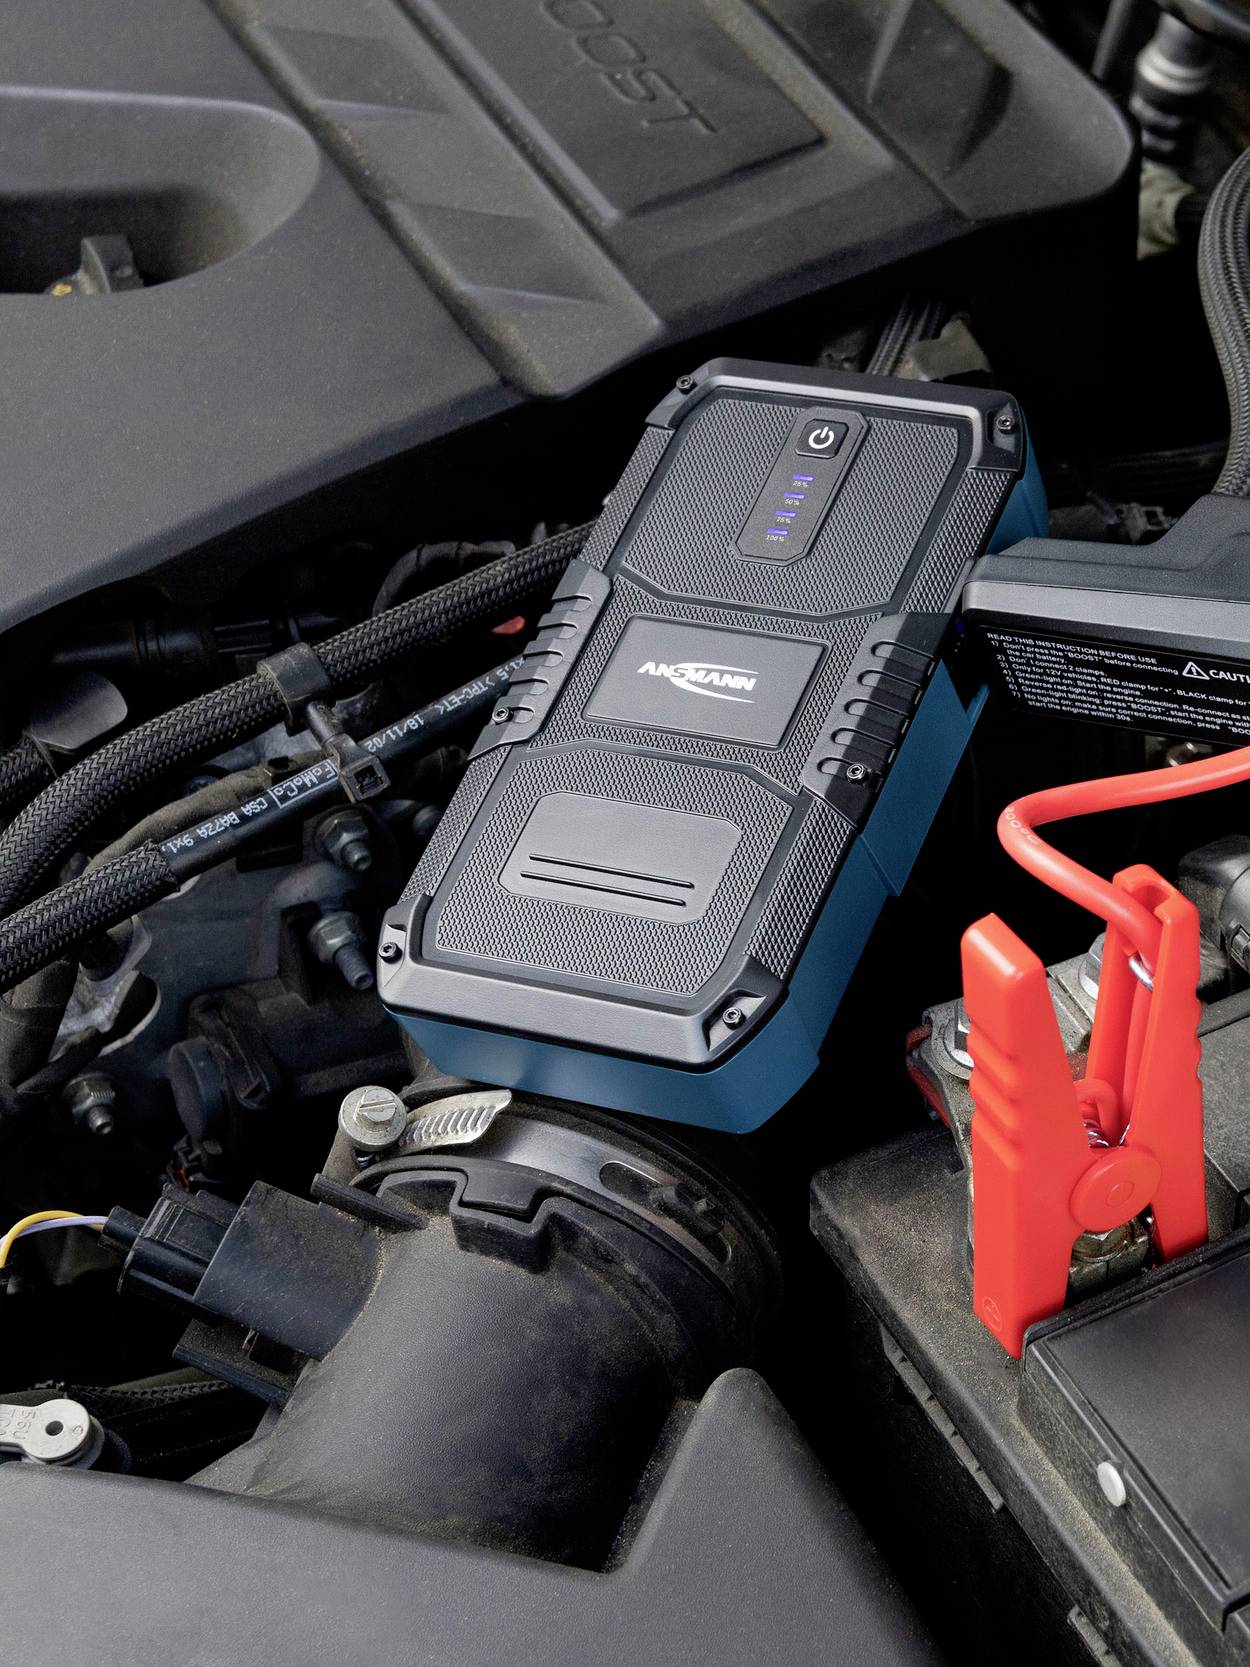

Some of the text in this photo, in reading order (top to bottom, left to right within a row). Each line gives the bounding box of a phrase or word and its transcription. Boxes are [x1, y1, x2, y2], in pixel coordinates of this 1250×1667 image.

[986, 633, 1157, 664] READ THIS INSTRUCTION BEFORE USE
[637, 661, 757, 691] ANSMANN
[1103, 658, 1131, 666] before
[1132, 663, 1178, 674] connecting
[1176, 689, 1207, 699] BLACK
[364, 714, 425, 753] 18/11/02
